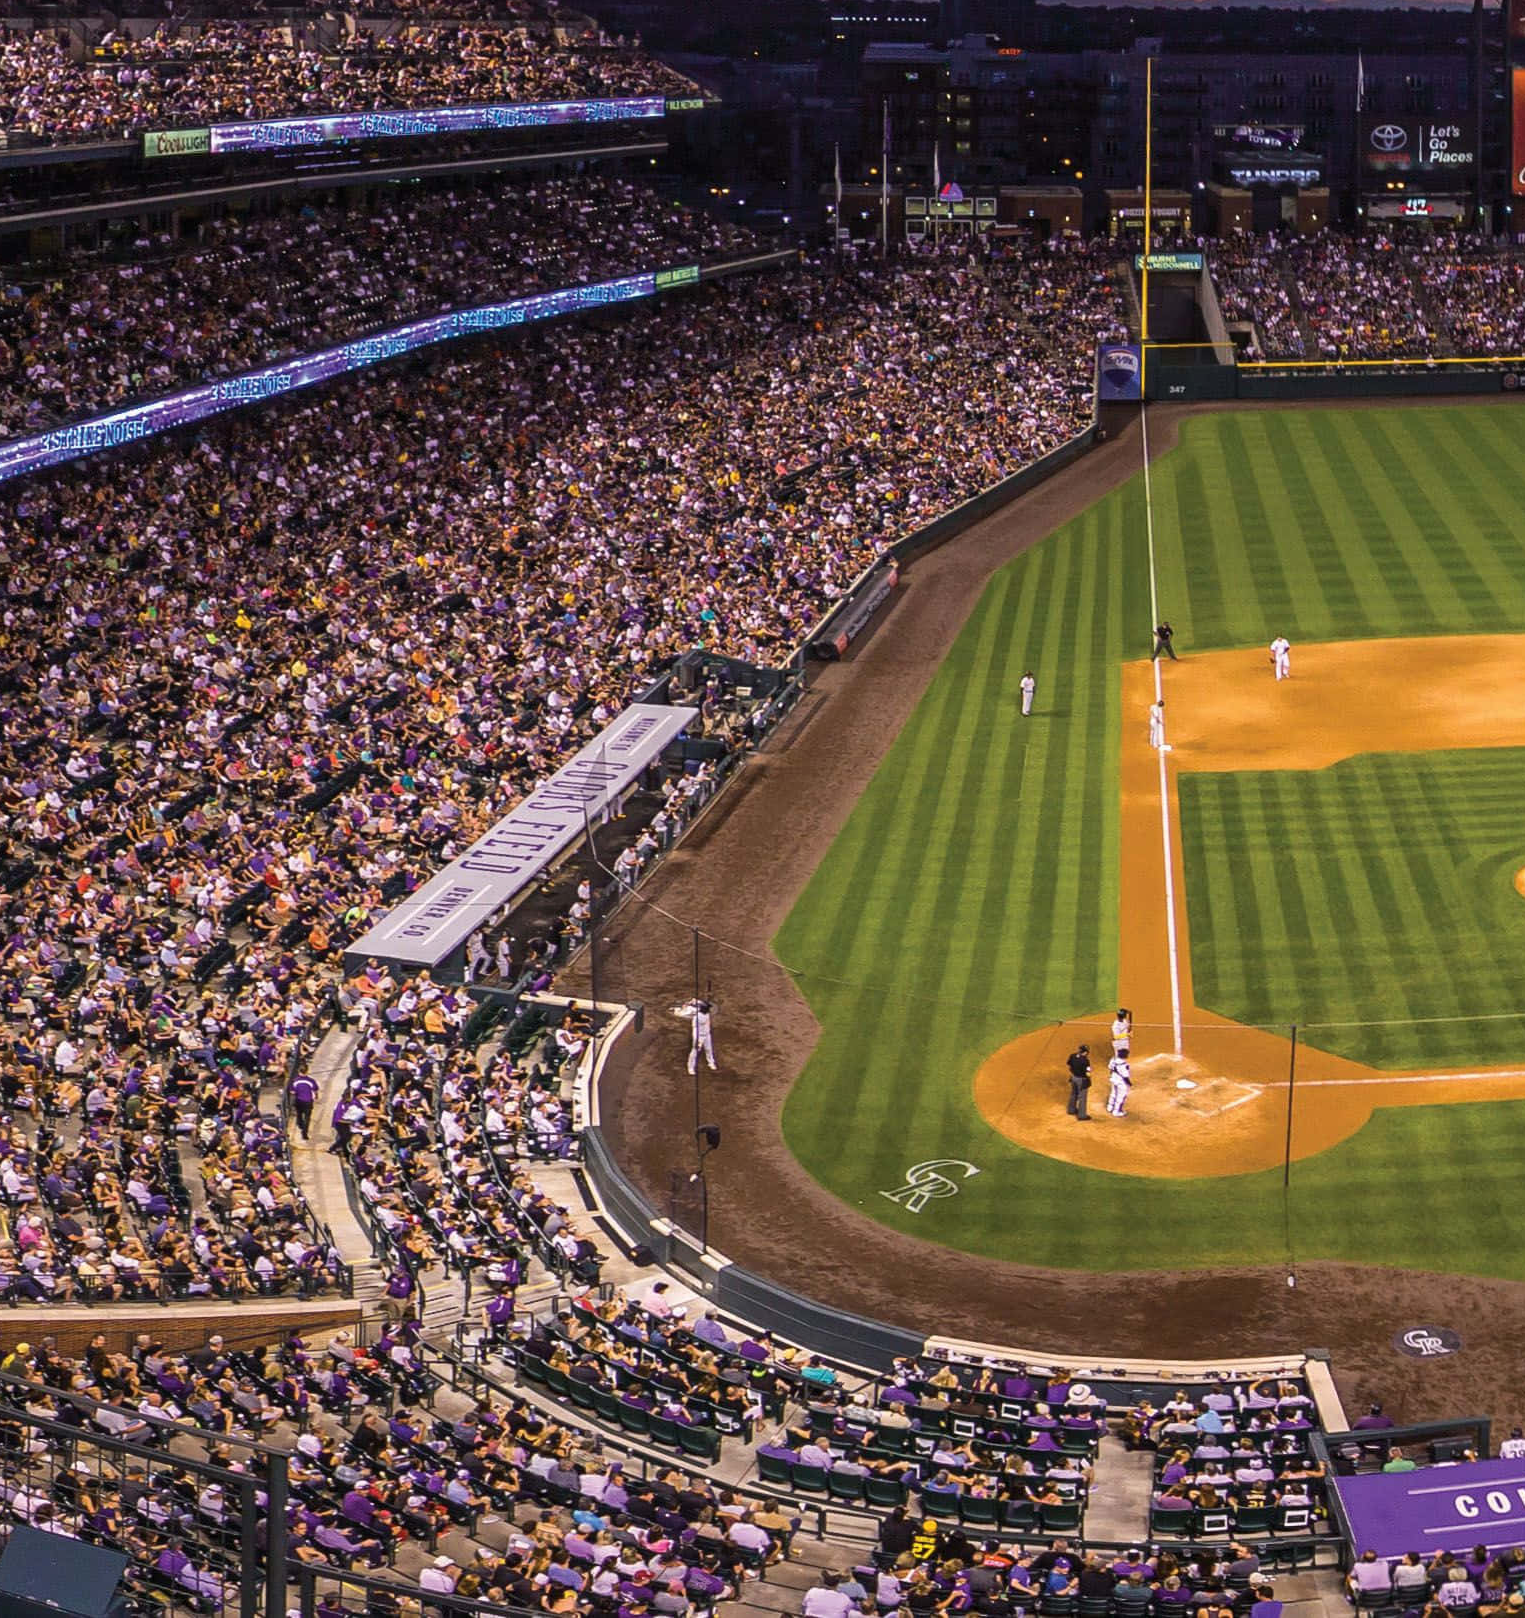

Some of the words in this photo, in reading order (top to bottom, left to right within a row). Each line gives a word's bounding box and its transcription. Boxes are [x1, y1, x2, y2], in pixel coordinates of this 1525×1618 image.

[1430, 125, 1460, 137] Let's
[157, 132, 186, 154] Coors
[1429, 139, 1448, 150] Go
[1430, 151, 1473, 163] Places
[527, 760, 629, 814] COORS
[460, 819, 567, 875] FIELD
[911, 1542, 936, 1559] 27
